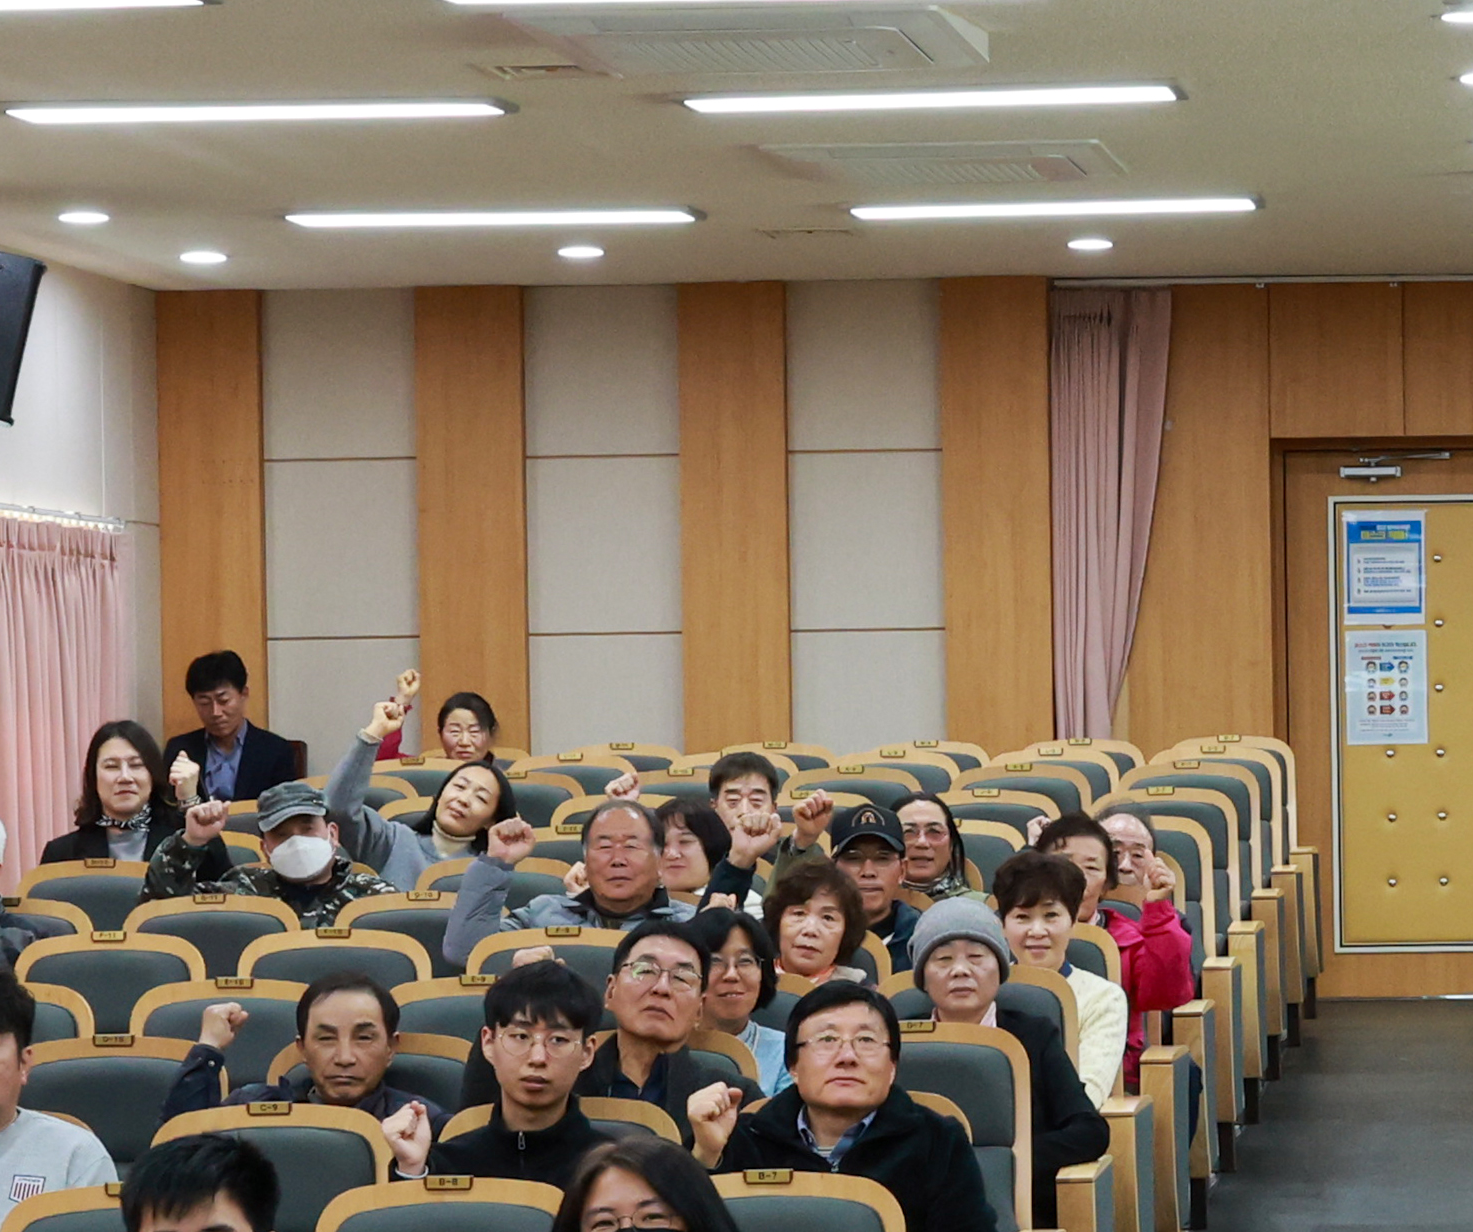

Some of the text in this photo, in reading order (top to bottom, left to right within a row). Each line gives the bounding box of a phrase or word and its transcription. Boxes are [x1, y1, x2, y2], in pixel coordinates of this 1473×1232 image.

[259, 1103, 279, 1112] C-9
[757, 1171, 778, 1181] B-7
[438, 1177, 459, 1187] B-8
